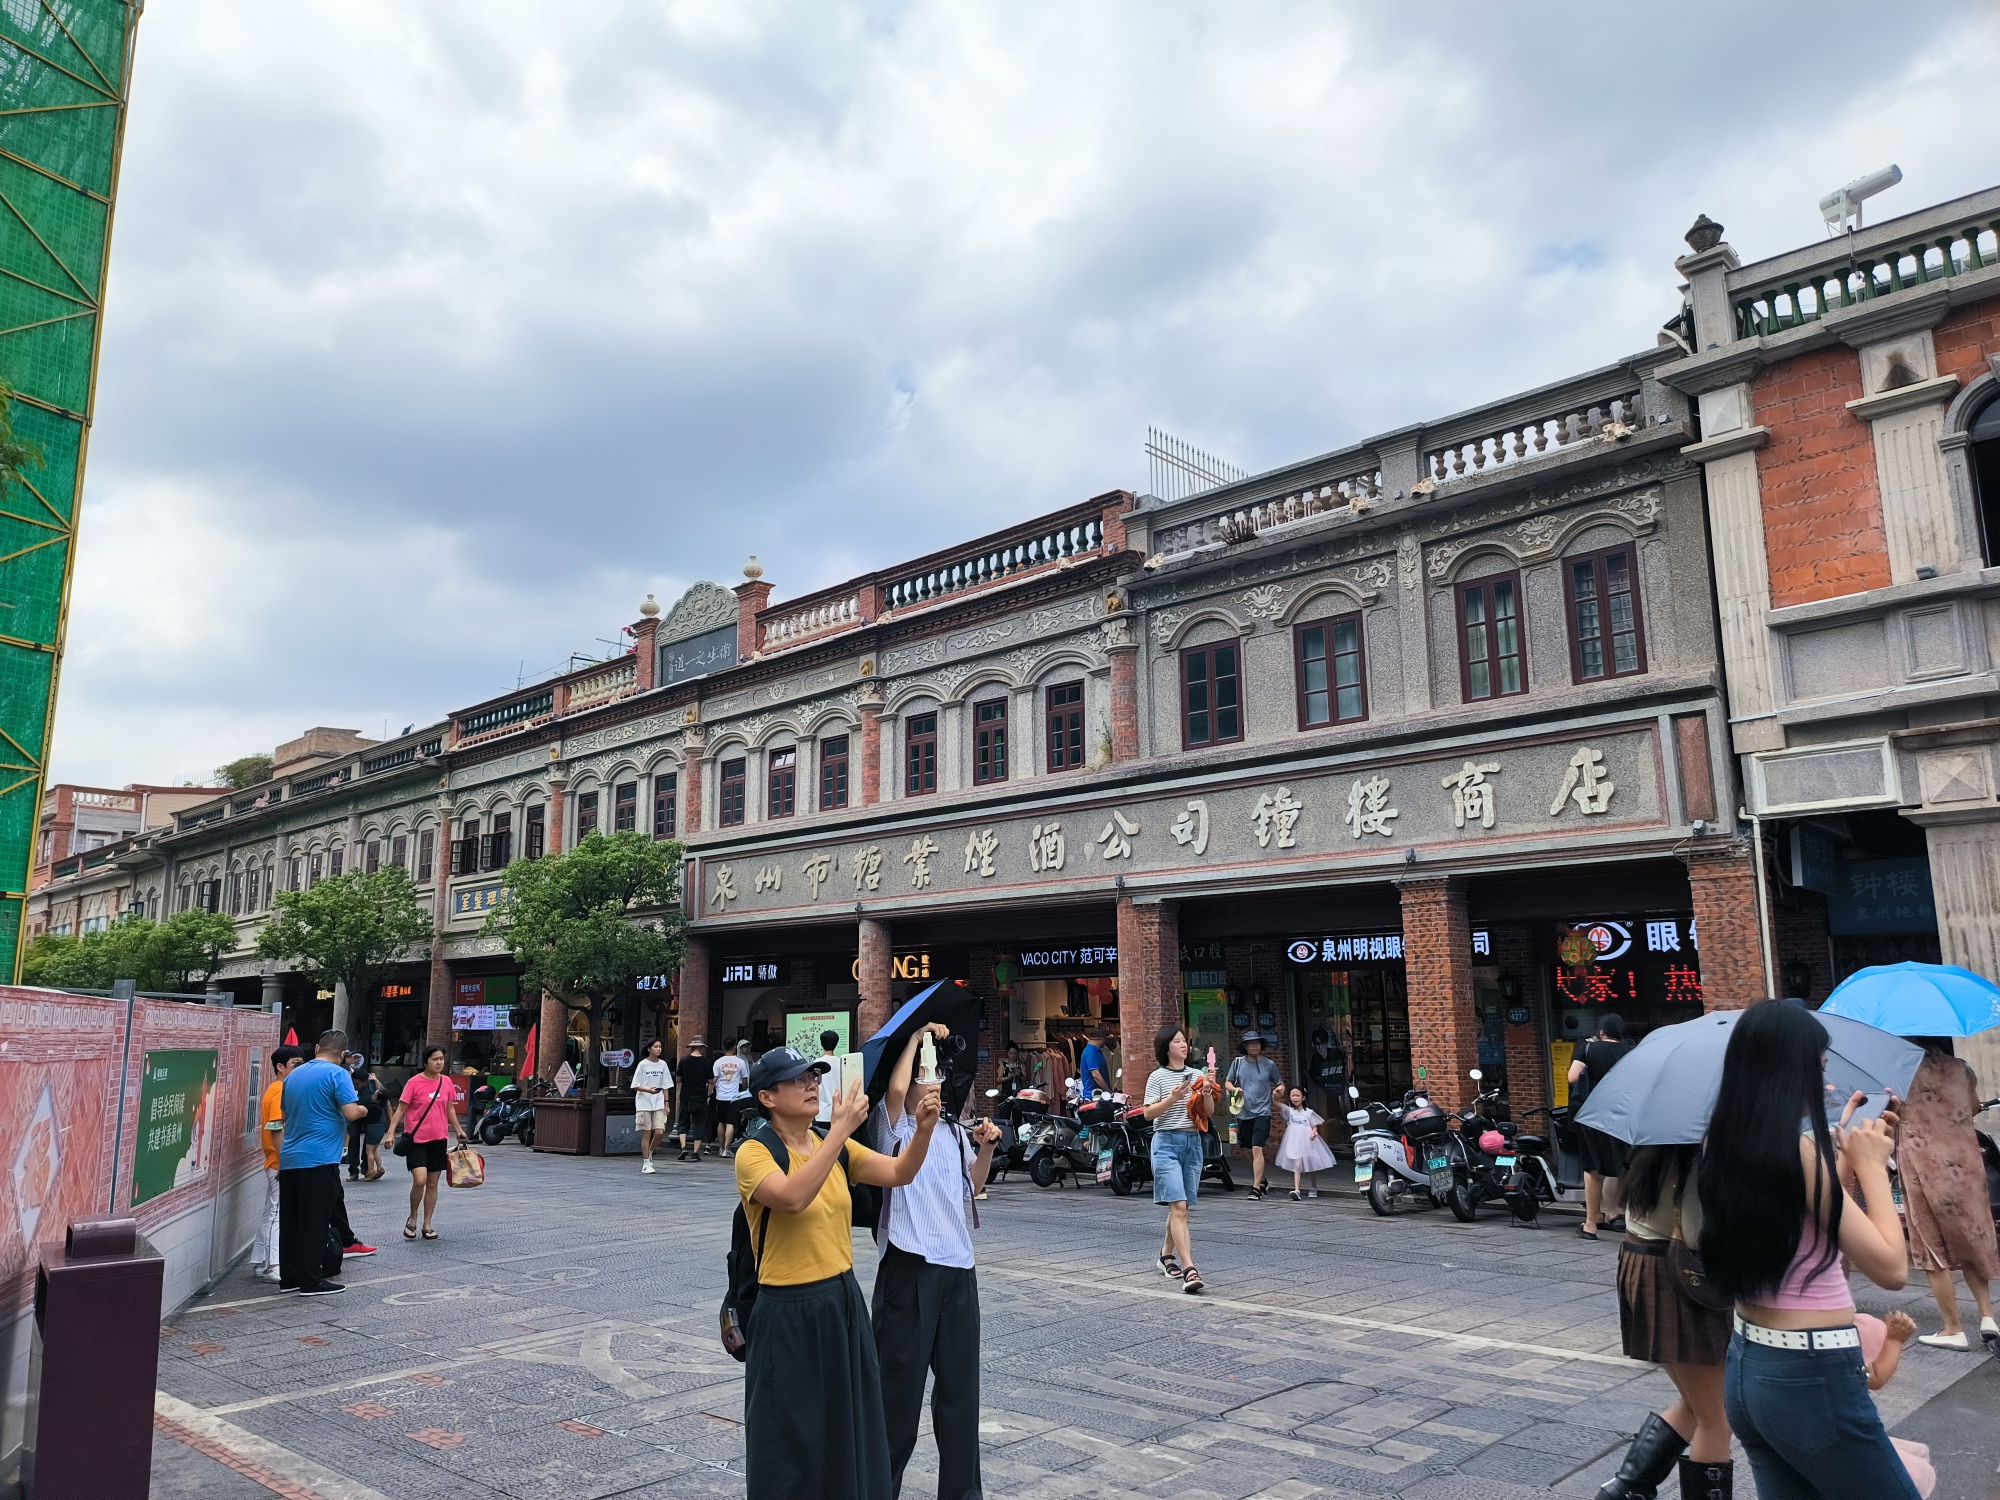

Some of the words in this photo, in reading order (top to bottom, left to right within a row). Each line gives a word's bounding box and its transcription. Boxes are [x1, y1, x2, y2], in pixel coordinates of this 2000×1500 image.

[1021, 951, 1050, 966] VACO
[1051, 950, 1077, 965] CITY
[1322, 936, 1405, 962] 泉州明视眼
[151, 1093, 185, 1122] 倡导全民阅读
[147, 1122, 183, 1152] 共建书香泉州
